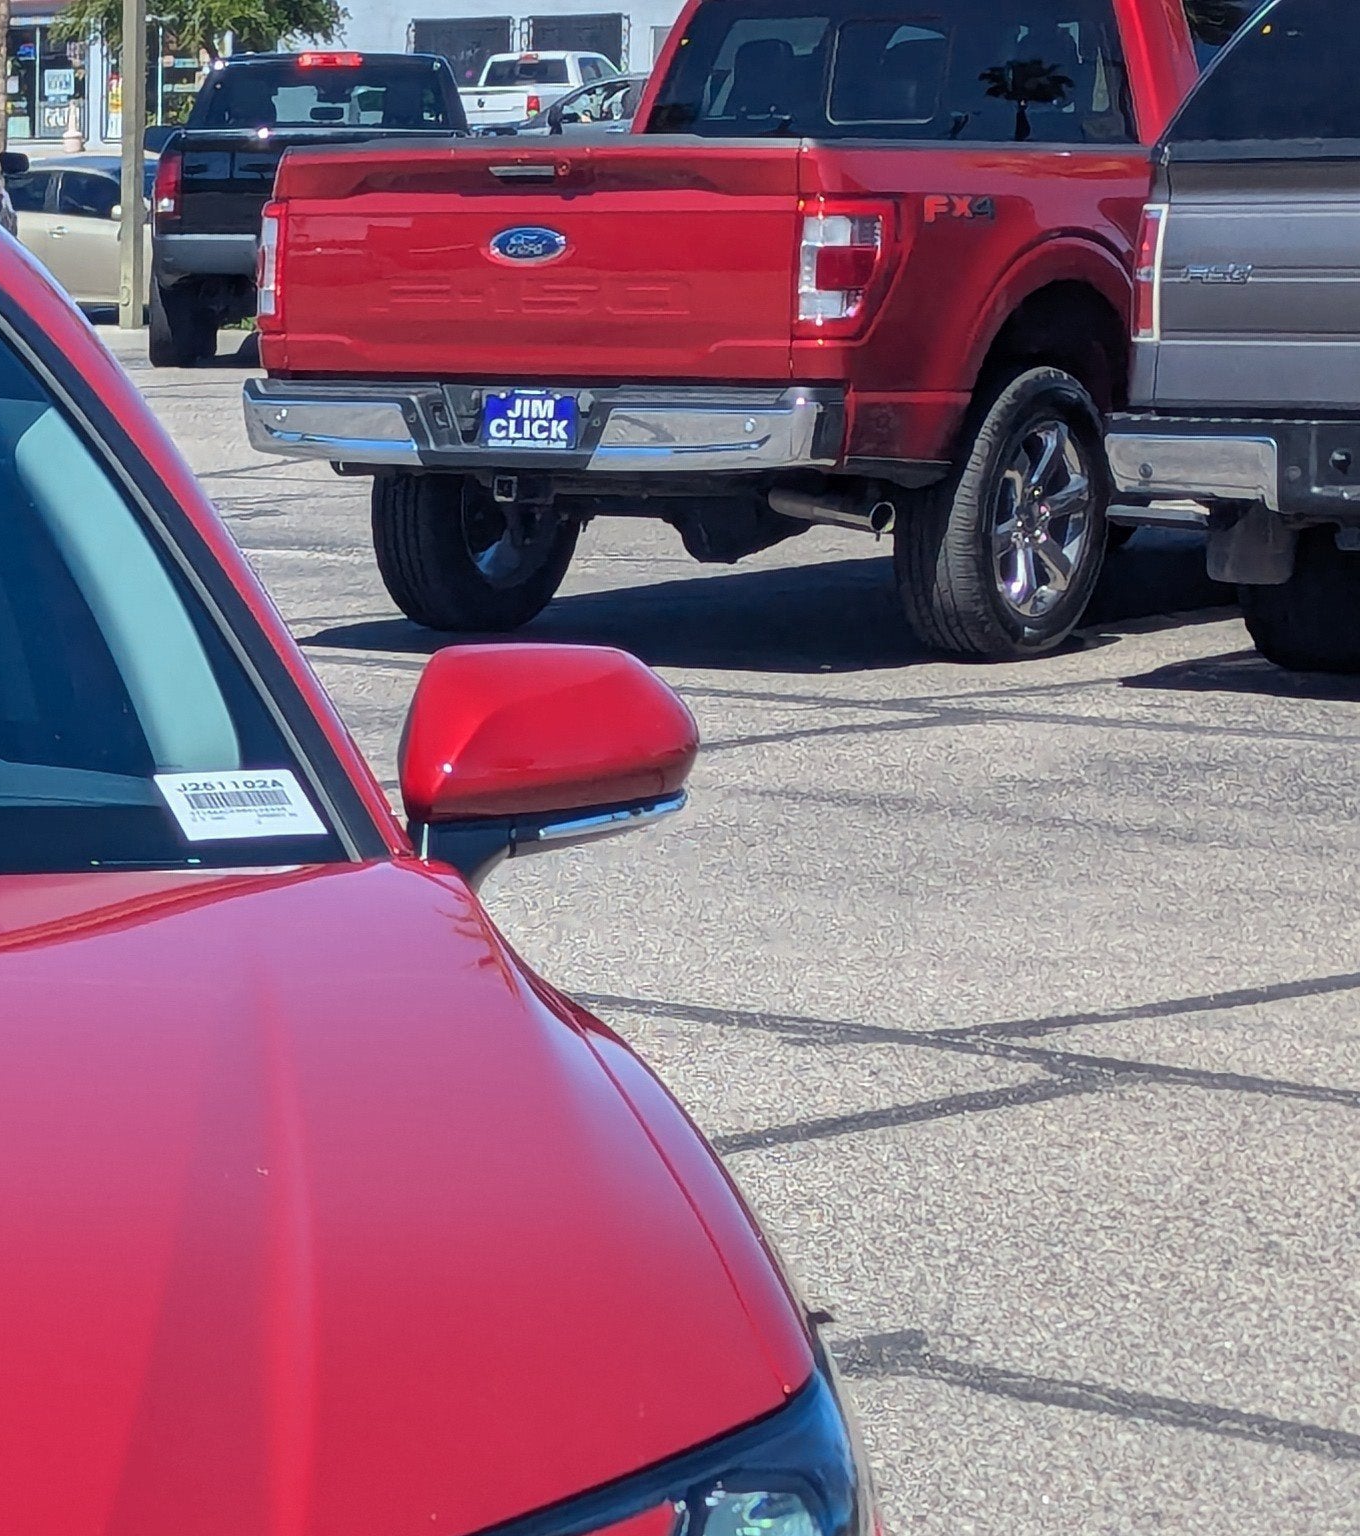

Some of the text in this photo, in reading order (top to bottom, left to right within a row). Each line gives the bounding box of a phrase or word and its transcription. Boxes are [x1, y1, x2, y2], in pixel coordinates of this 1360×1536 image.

[924, 195, 995, 223] FX4
[505, 233, 548, 255] Ford
[507, 398, 555, 419] JIM
[489, 418, 569, 439] CLICK
